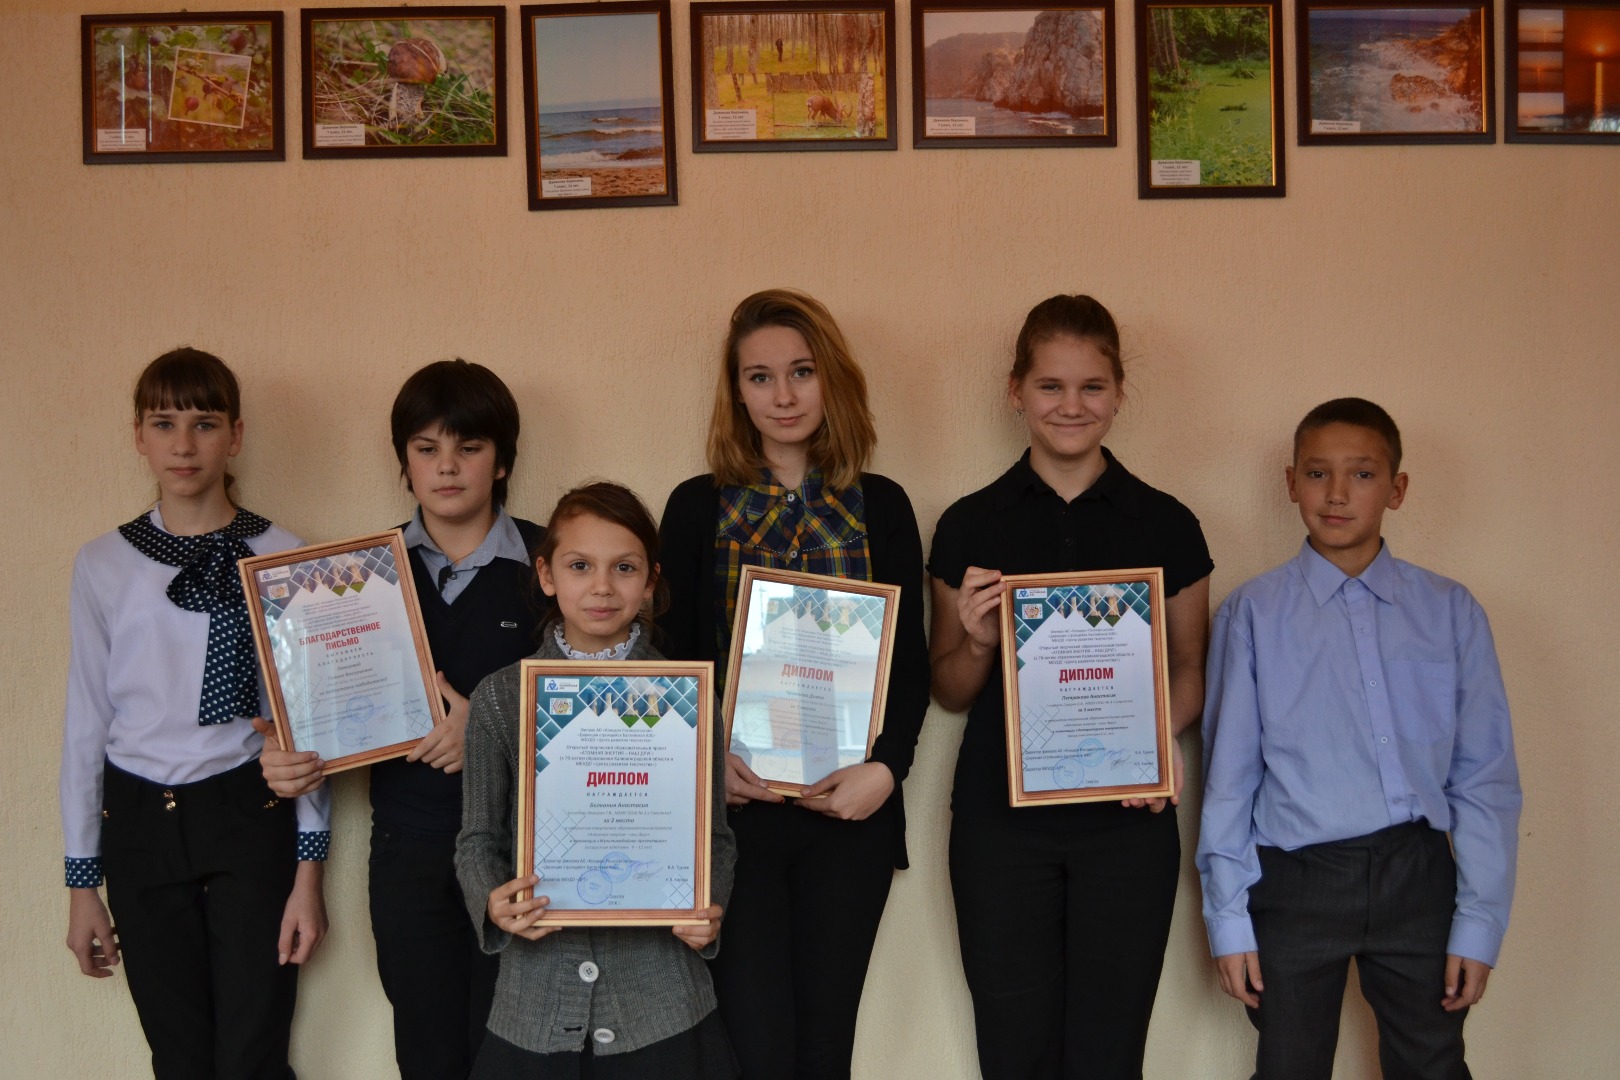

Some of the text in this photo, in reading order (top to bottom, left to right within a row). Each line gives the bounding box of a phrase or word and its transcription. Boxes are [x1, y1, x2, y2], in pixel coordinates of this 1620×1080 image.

[299, 622, 381, 646] БЛАГОДАРСТВЕННОЕ
[326, 636, 359, 650] ПИСЬМО
[782, 664, 833, 682] ДИПЛОМ
[1059, 667, 1113, 683] ДИПЛОМ
[587, 772, 648, 787] ДИПЛОМ
